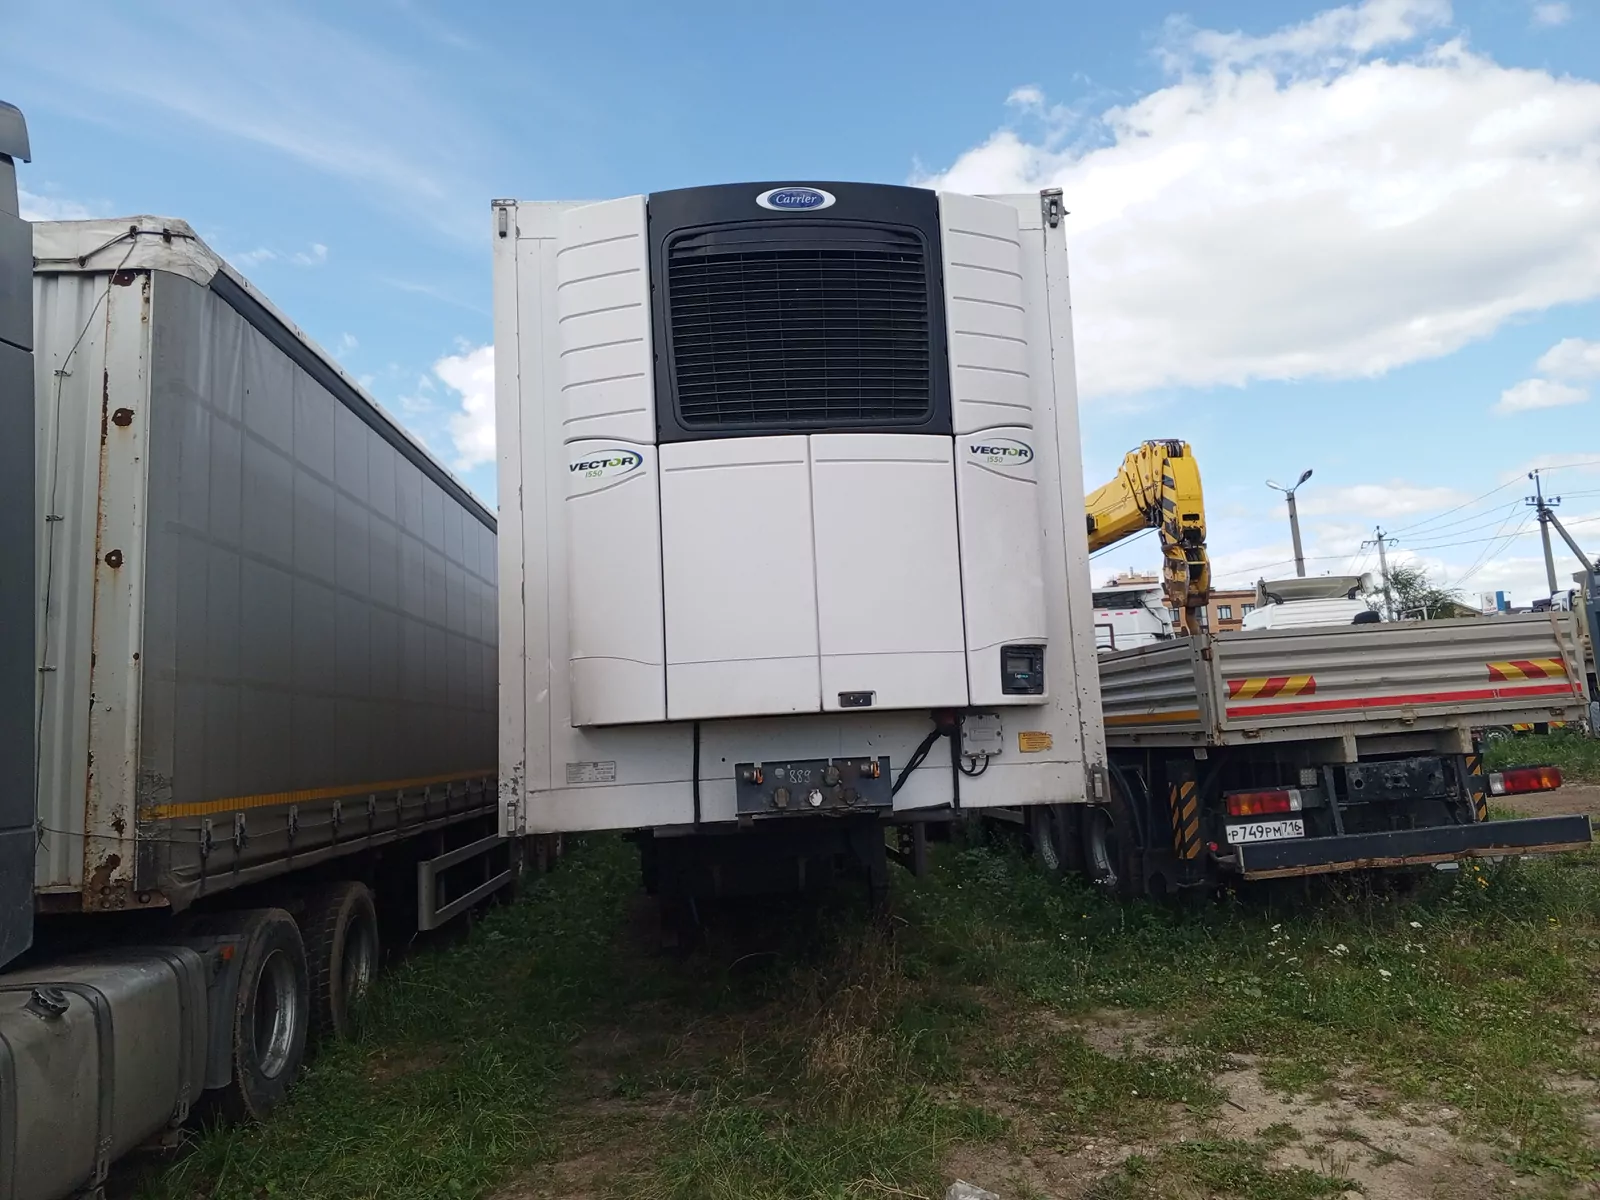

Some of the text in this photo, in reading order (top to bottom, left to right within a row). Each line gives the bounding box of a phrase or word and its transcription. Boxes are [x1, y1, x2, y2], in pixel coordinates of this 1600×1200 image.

[775, 194, 817, 204] Carrier
[970, 445, 1029, 458] VECTOR
[569, 457, 634, 472] VECTOR
[585, 469, 603, 478] 1550
